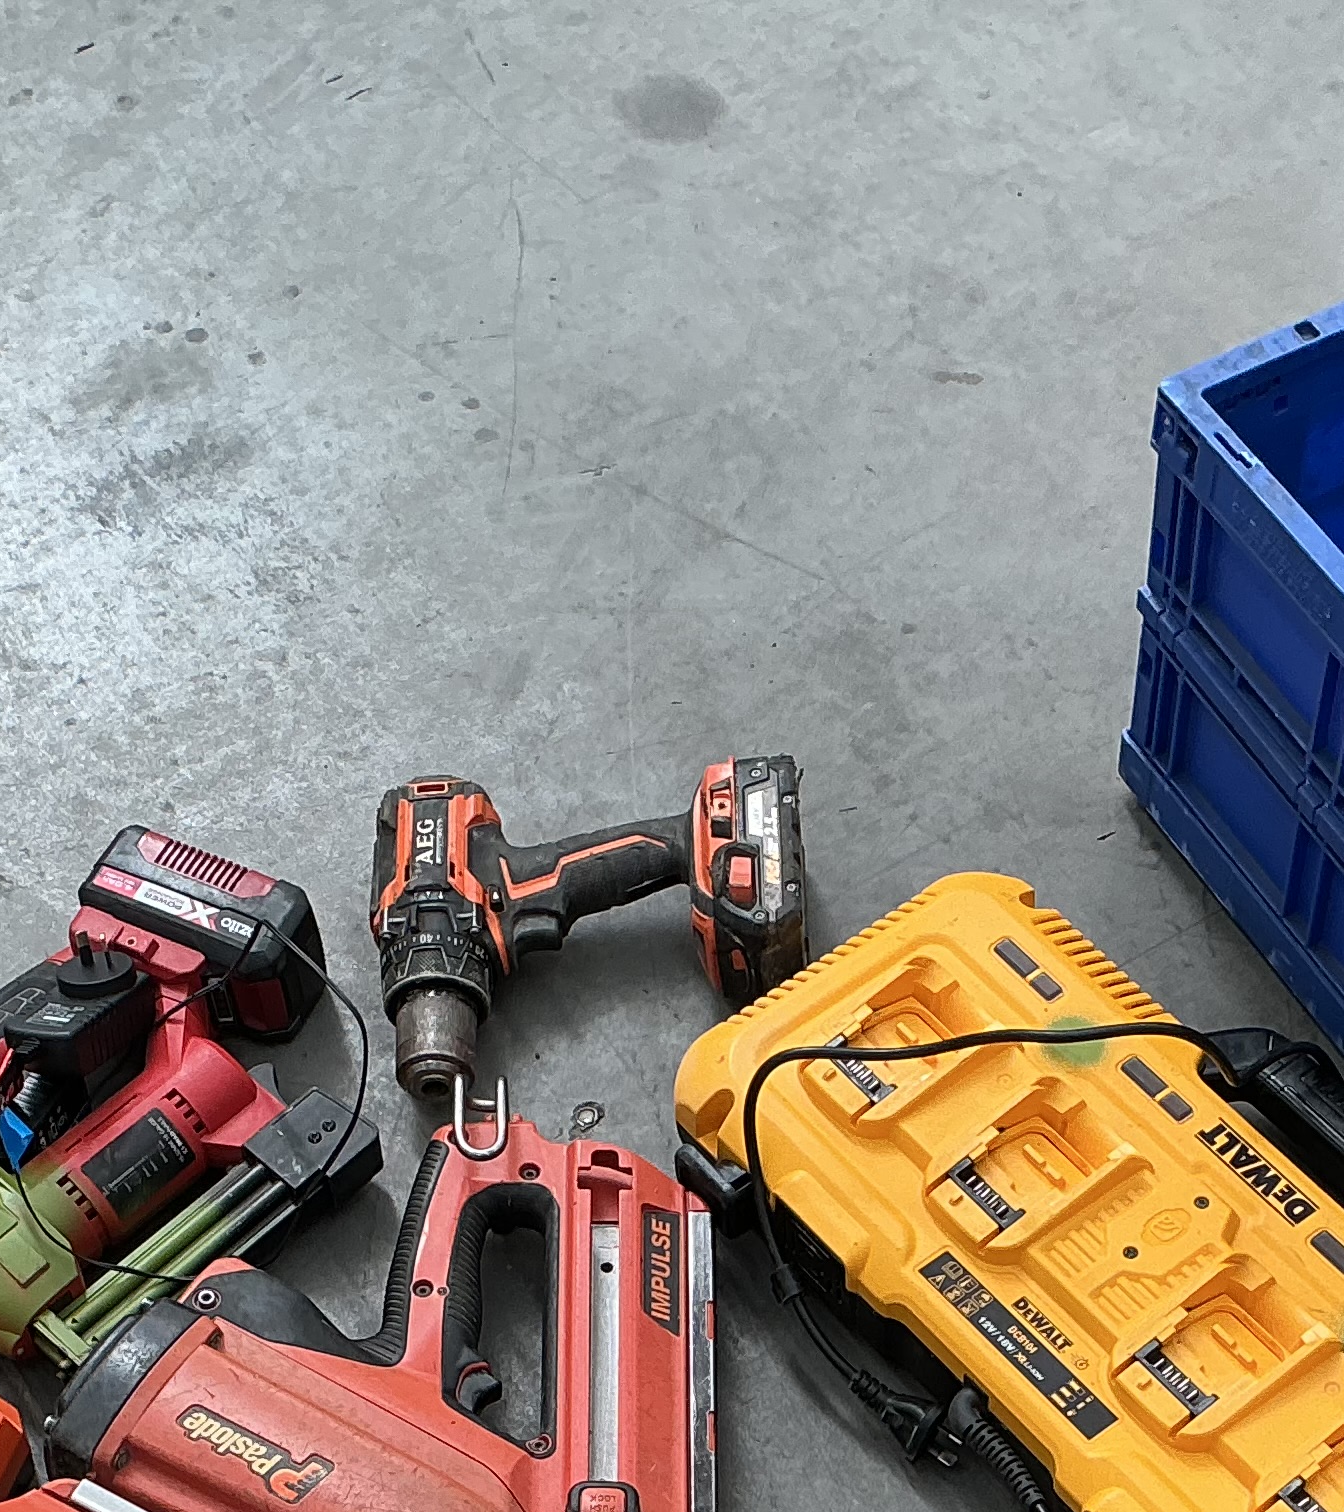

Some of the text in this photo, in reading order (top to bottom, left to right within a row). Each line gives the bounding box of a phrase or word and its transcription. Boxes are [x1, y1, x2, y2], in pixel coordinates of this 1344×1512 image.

[414, 819, 434, 864] AEG
[143, 890, 183, 911] POWER
[1195, 1117, 1318, 1226] DEWALT
[649, 1217, 670, 1321] IMPULSE
[1010, 1295, 1072, 1353] DEWALT
[181, 1408, 283, 1477] Paslode
[588, 1503, 615, 1512] PUSH
